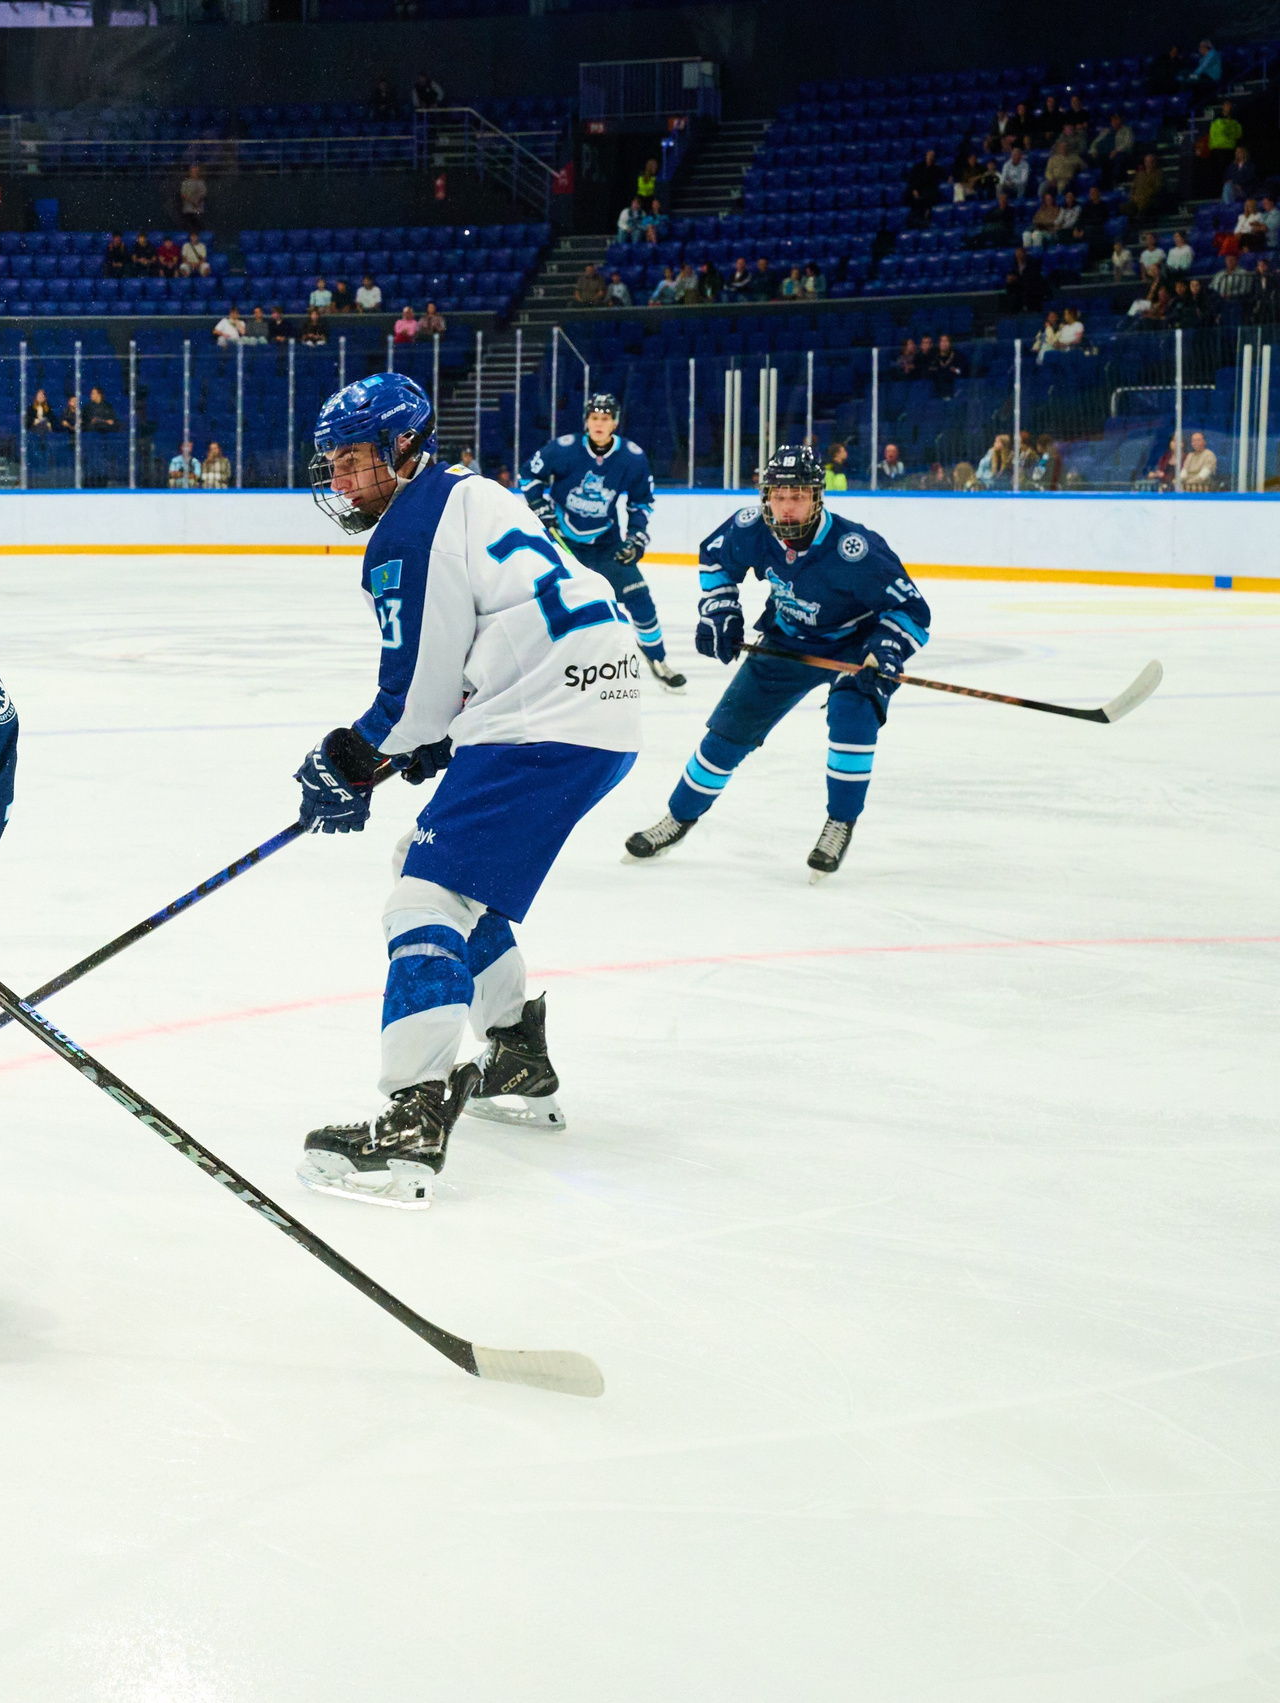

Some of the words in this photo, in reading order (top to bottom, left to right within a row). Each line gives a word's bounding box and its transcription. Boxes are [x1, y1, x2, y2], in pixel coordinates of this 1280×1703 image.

[564, 653, 641, 692] sportQ
[501, 1068, 528, 1094] CCM
[102, 1085, 293, 1230] SOYUZ
